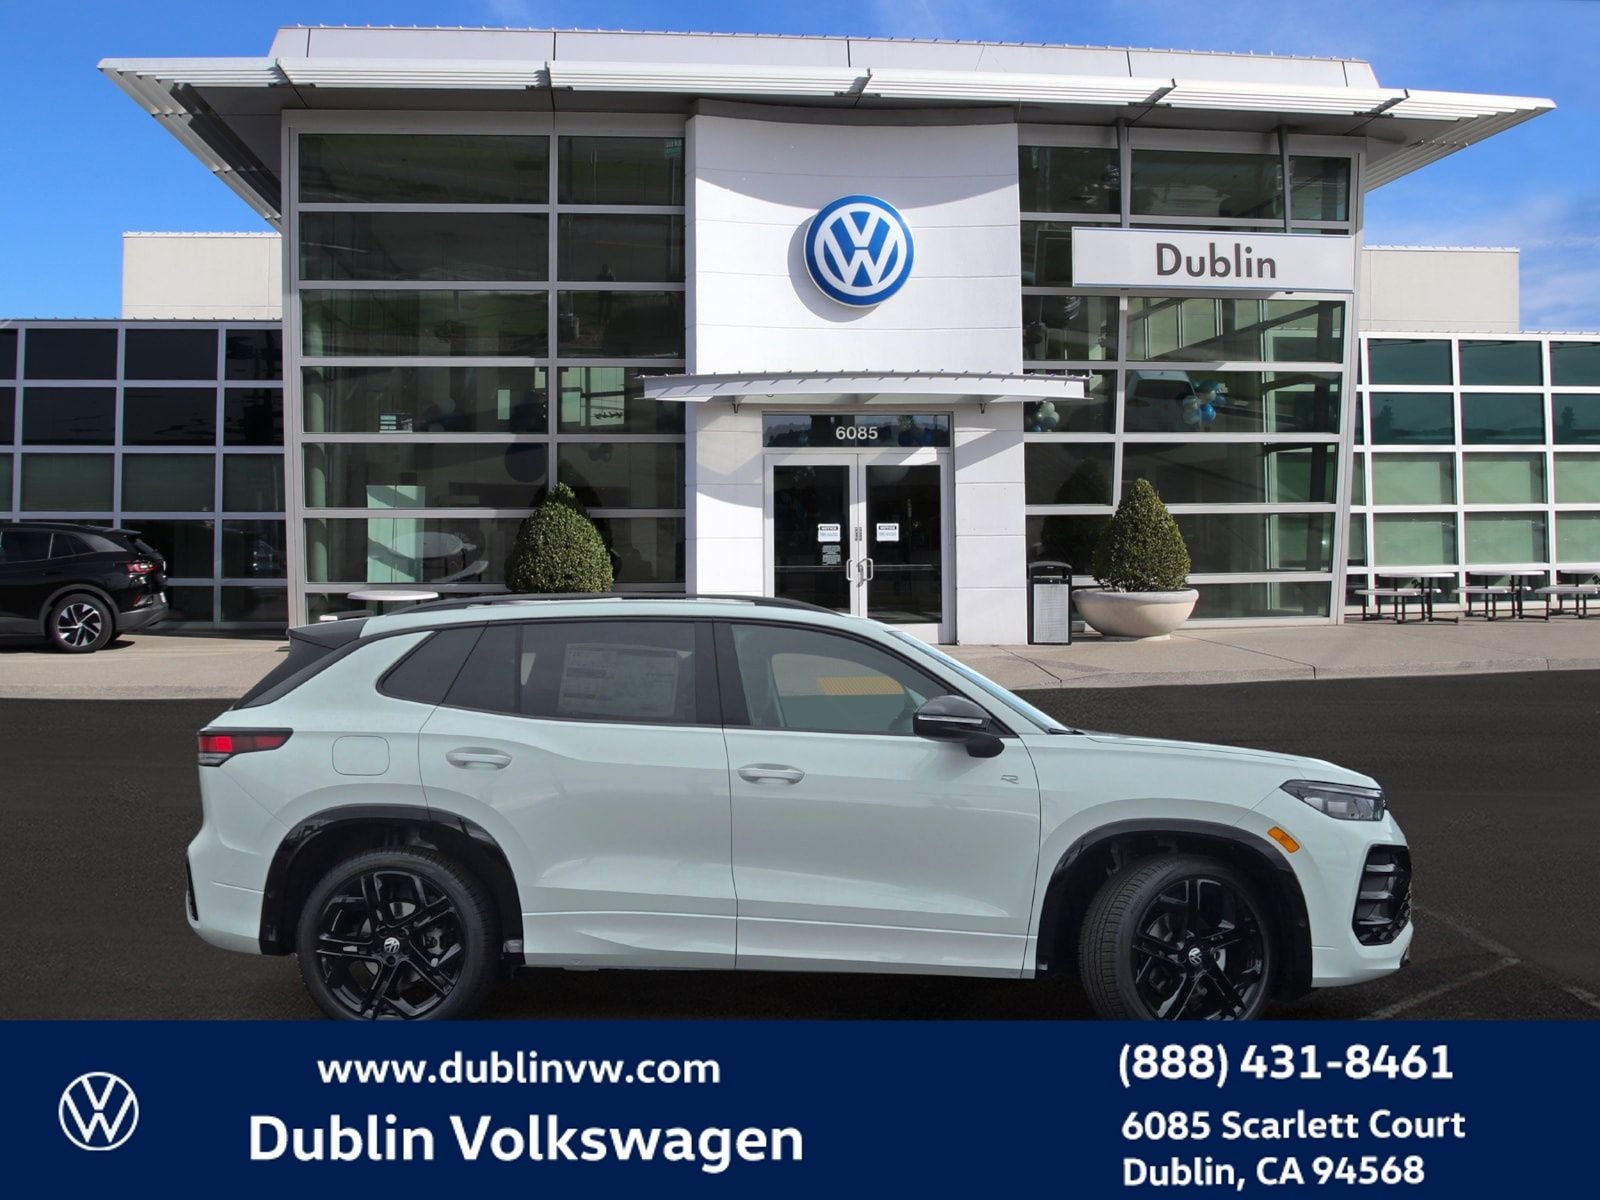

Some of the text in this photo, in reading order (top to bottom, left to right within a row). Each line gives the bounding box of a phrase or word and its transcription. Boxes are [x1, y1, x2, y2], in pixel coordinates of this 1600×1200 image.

[814, 203, 907, 296] VW
[1156, 242, 1276, 278] Dublin
[836, 426, 878, 440] 6085
